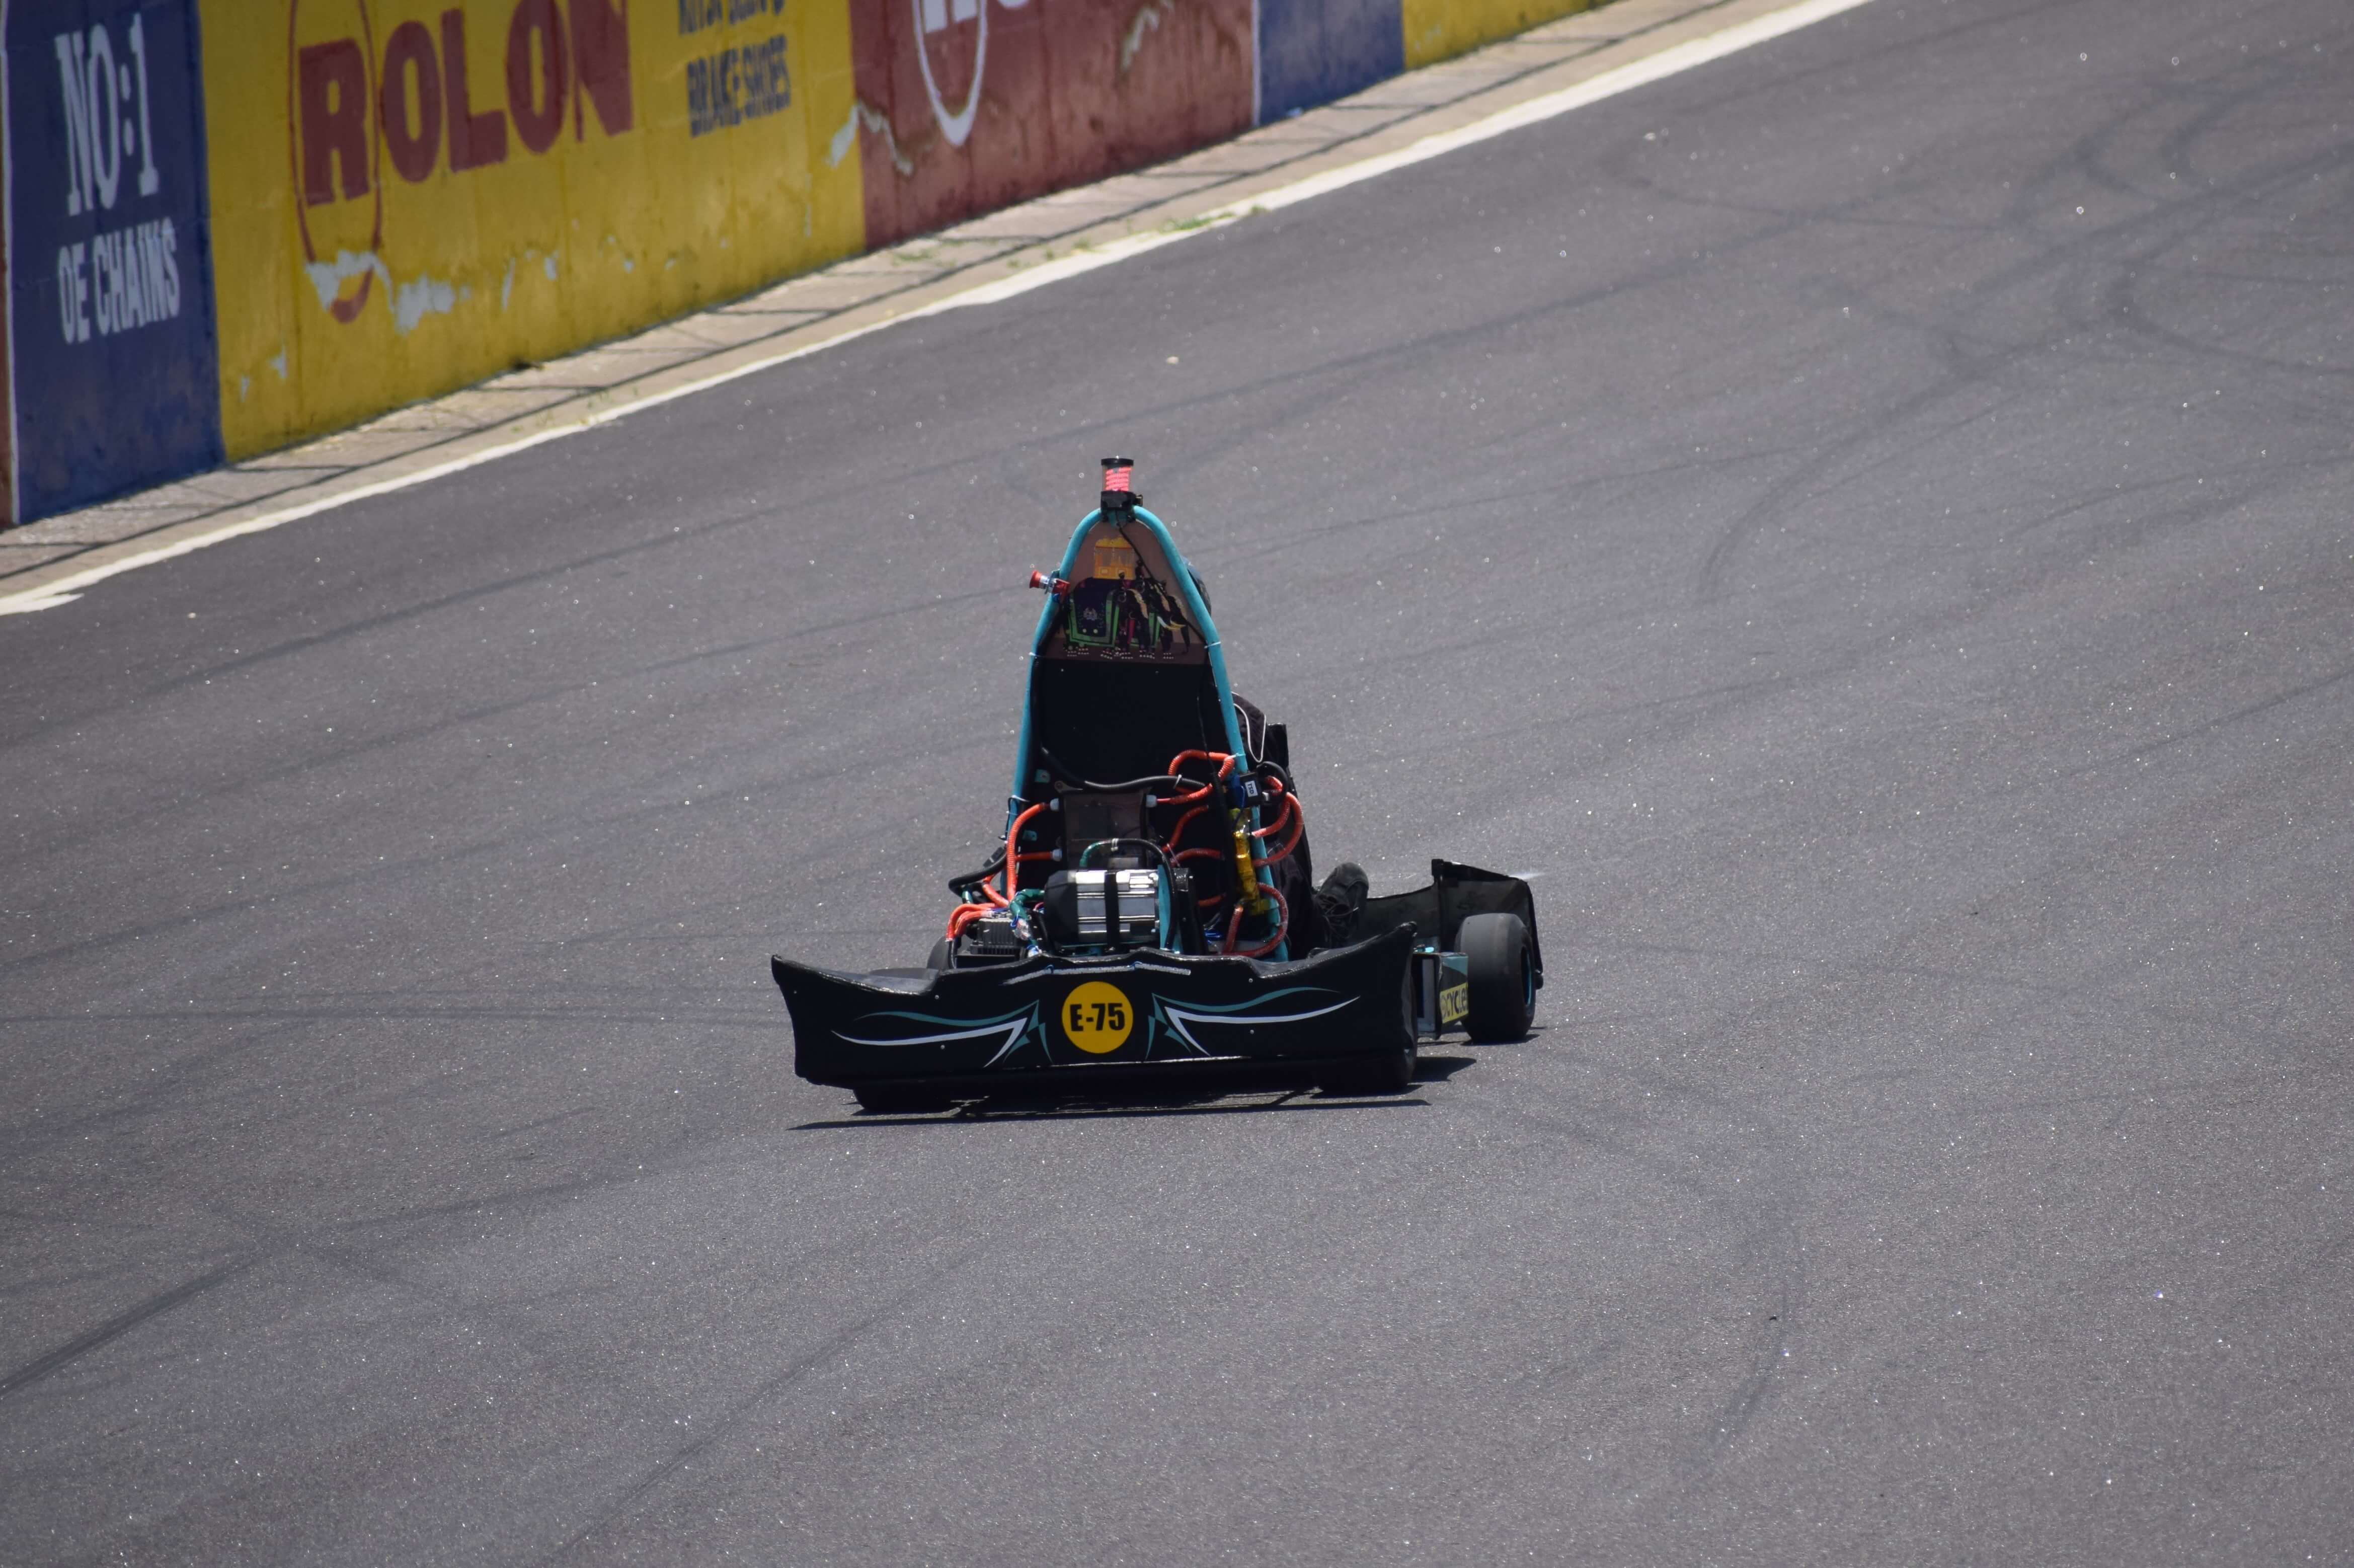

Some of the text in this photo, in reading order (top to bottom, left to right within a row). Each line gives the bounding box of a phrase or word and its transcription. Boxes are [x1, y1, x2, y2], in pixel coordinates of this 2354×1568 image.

[55, 12, 159, 216] NO:1
[298, 0, 634, 208] ROLON
[93, 216, 180, 336] CHAINS
[1070, 1002, 1125, 1032] E-75
